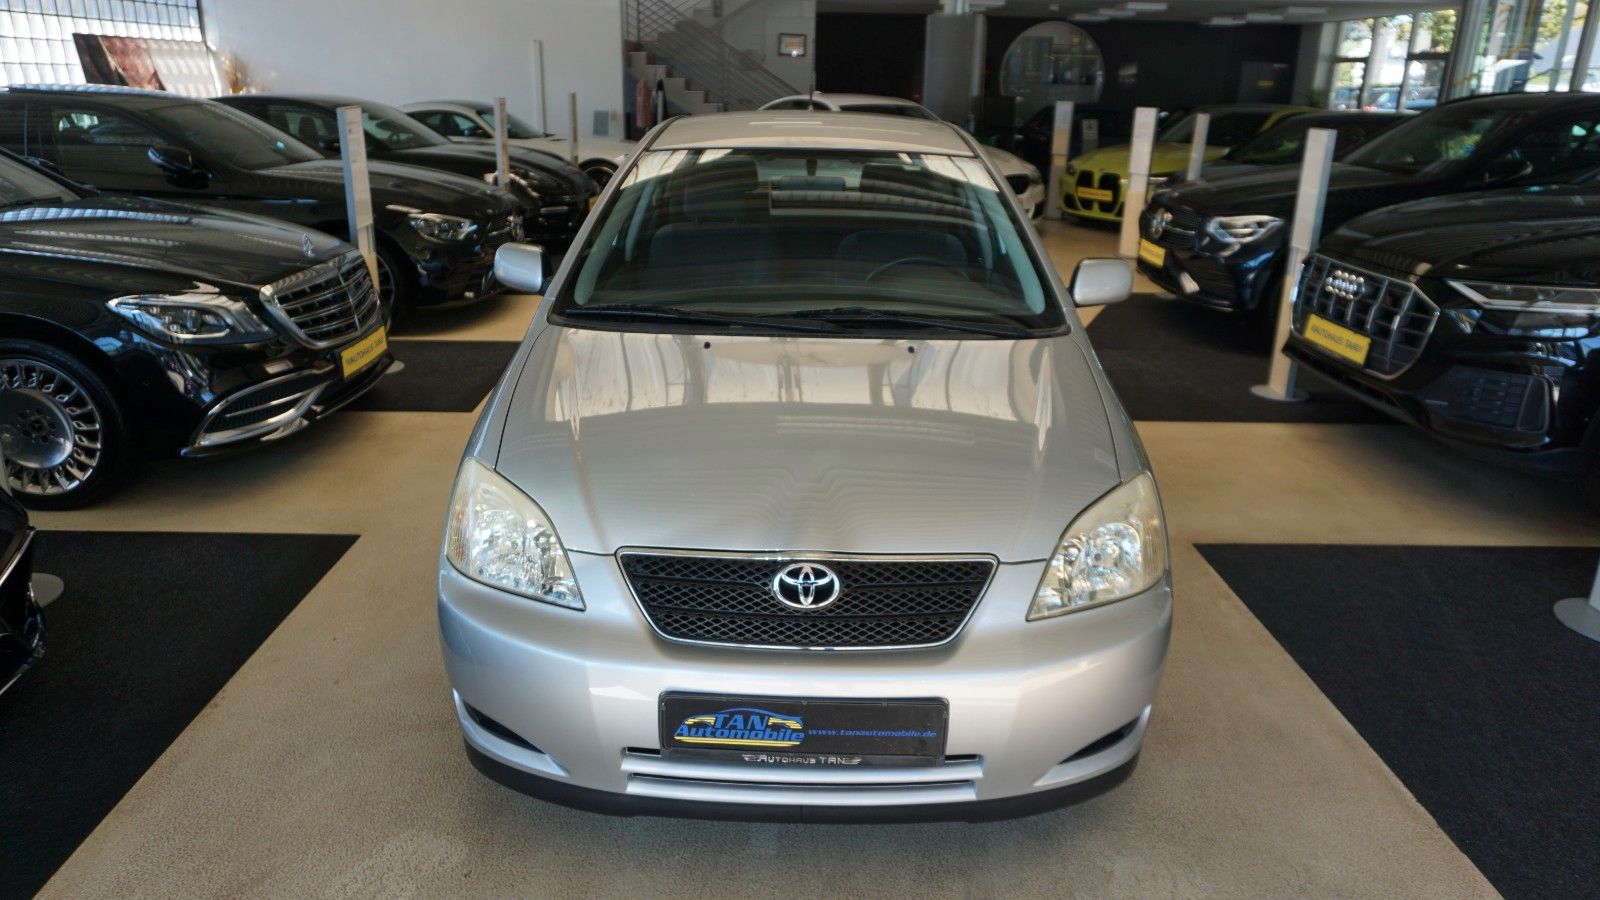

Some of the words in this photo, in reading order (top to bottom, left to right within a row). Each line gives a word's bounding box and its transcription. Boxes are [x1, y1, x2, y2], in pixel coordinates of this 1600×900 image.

[714, 713, 769, 731] TAN
[674, 725, 805, 742] Automobile
[808, 728, 937, 738] www.tanautomobile.de
[758, 754, 816, 764] AUTOHAUS
[819, 757, 845, 765] TAN
